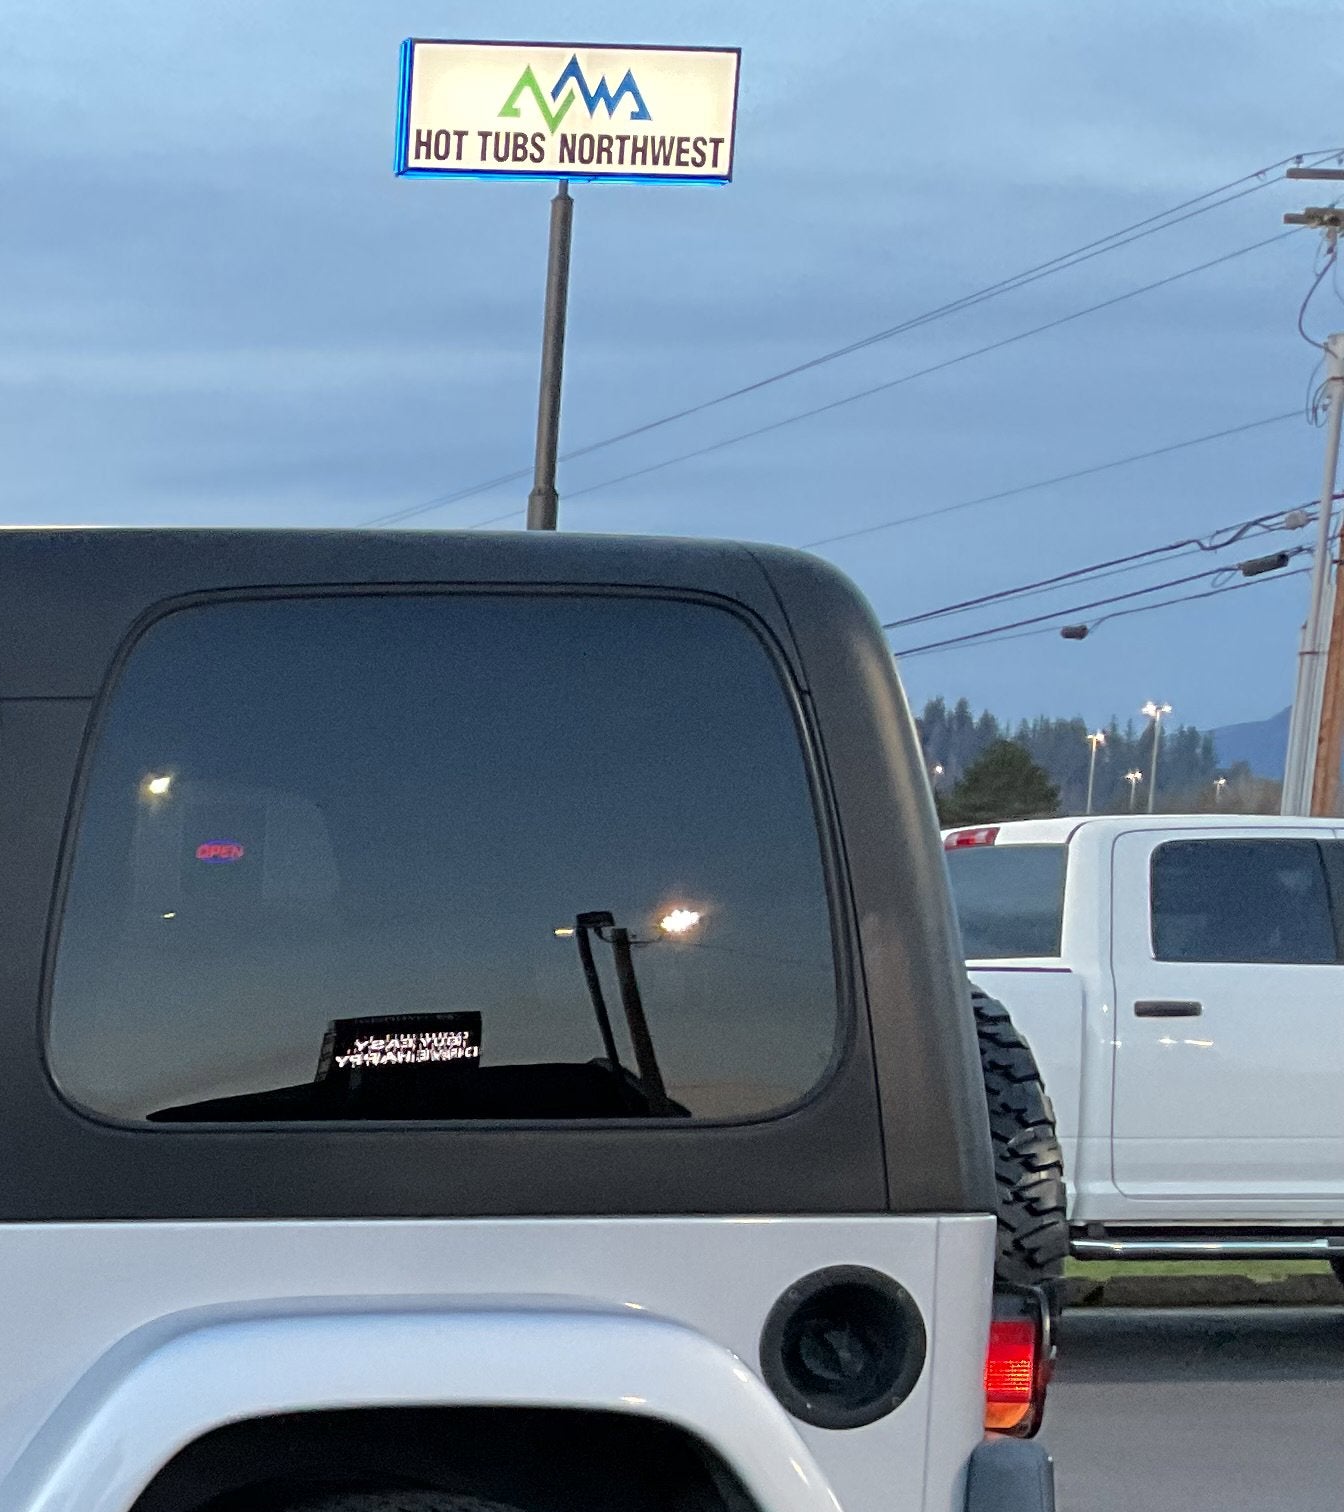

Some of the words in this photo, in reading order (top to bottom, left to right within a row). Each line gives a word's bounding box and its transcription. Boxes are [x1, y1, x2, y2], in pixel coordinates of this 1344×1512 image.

[414, 129, 469, 161] HOT
[477, 130, 546, 163] TUBS
[558, 132, 725, 169] NORTHWEST
[195, 843, 244, 859] OPEN
